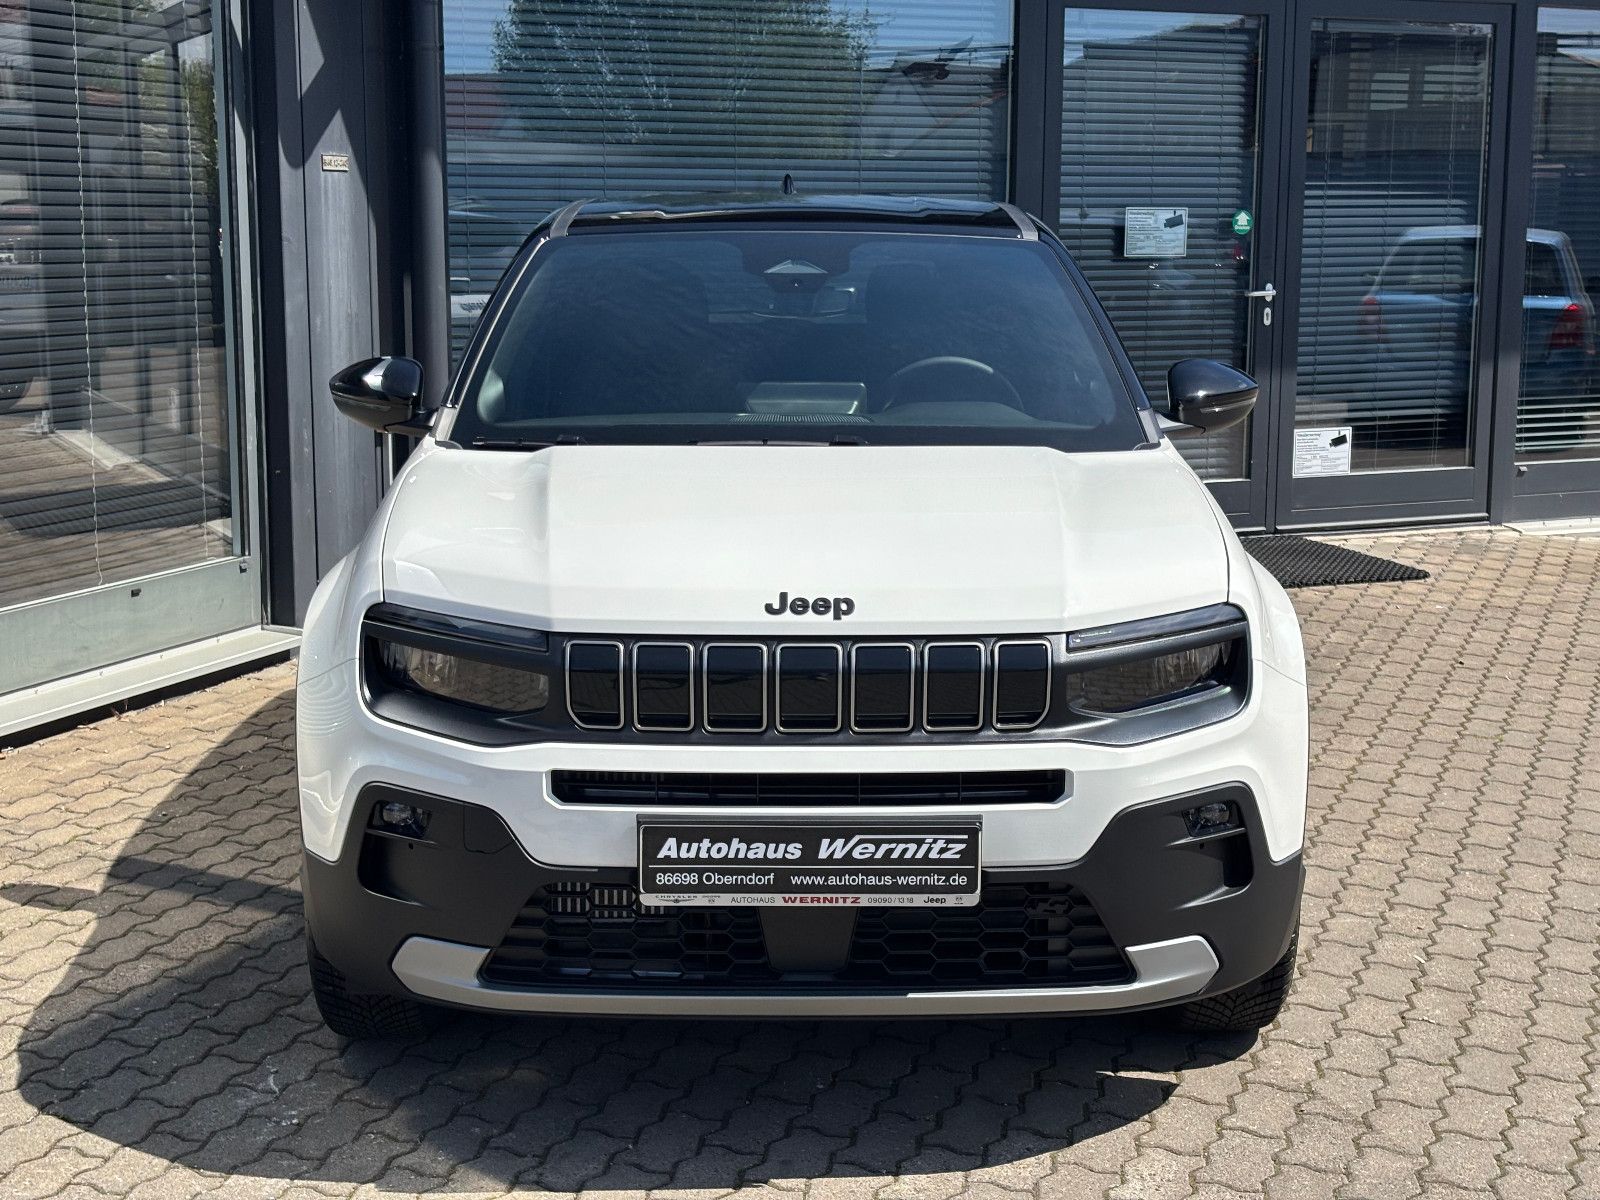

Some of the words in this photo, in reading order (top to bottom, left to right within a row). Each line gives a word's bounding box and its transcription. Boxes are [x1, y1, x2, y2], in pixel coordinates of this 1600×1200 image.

[764, 592, 856, 620] Jeep
[656, 837, 803, 859] Autohaus
[817, 834, 969, 859] Wernitz
[655, 872, 699, 885] 86698
[702, 872, 775, 885] Oberndorf
[790, 872, 968, 886] www.autohaus-wernitz.de
[730, 896, 776, 904] AUTOHAUS
[781, 896, 861, 904] WERNITZ
[924, 896, 947, 905] Jeep
